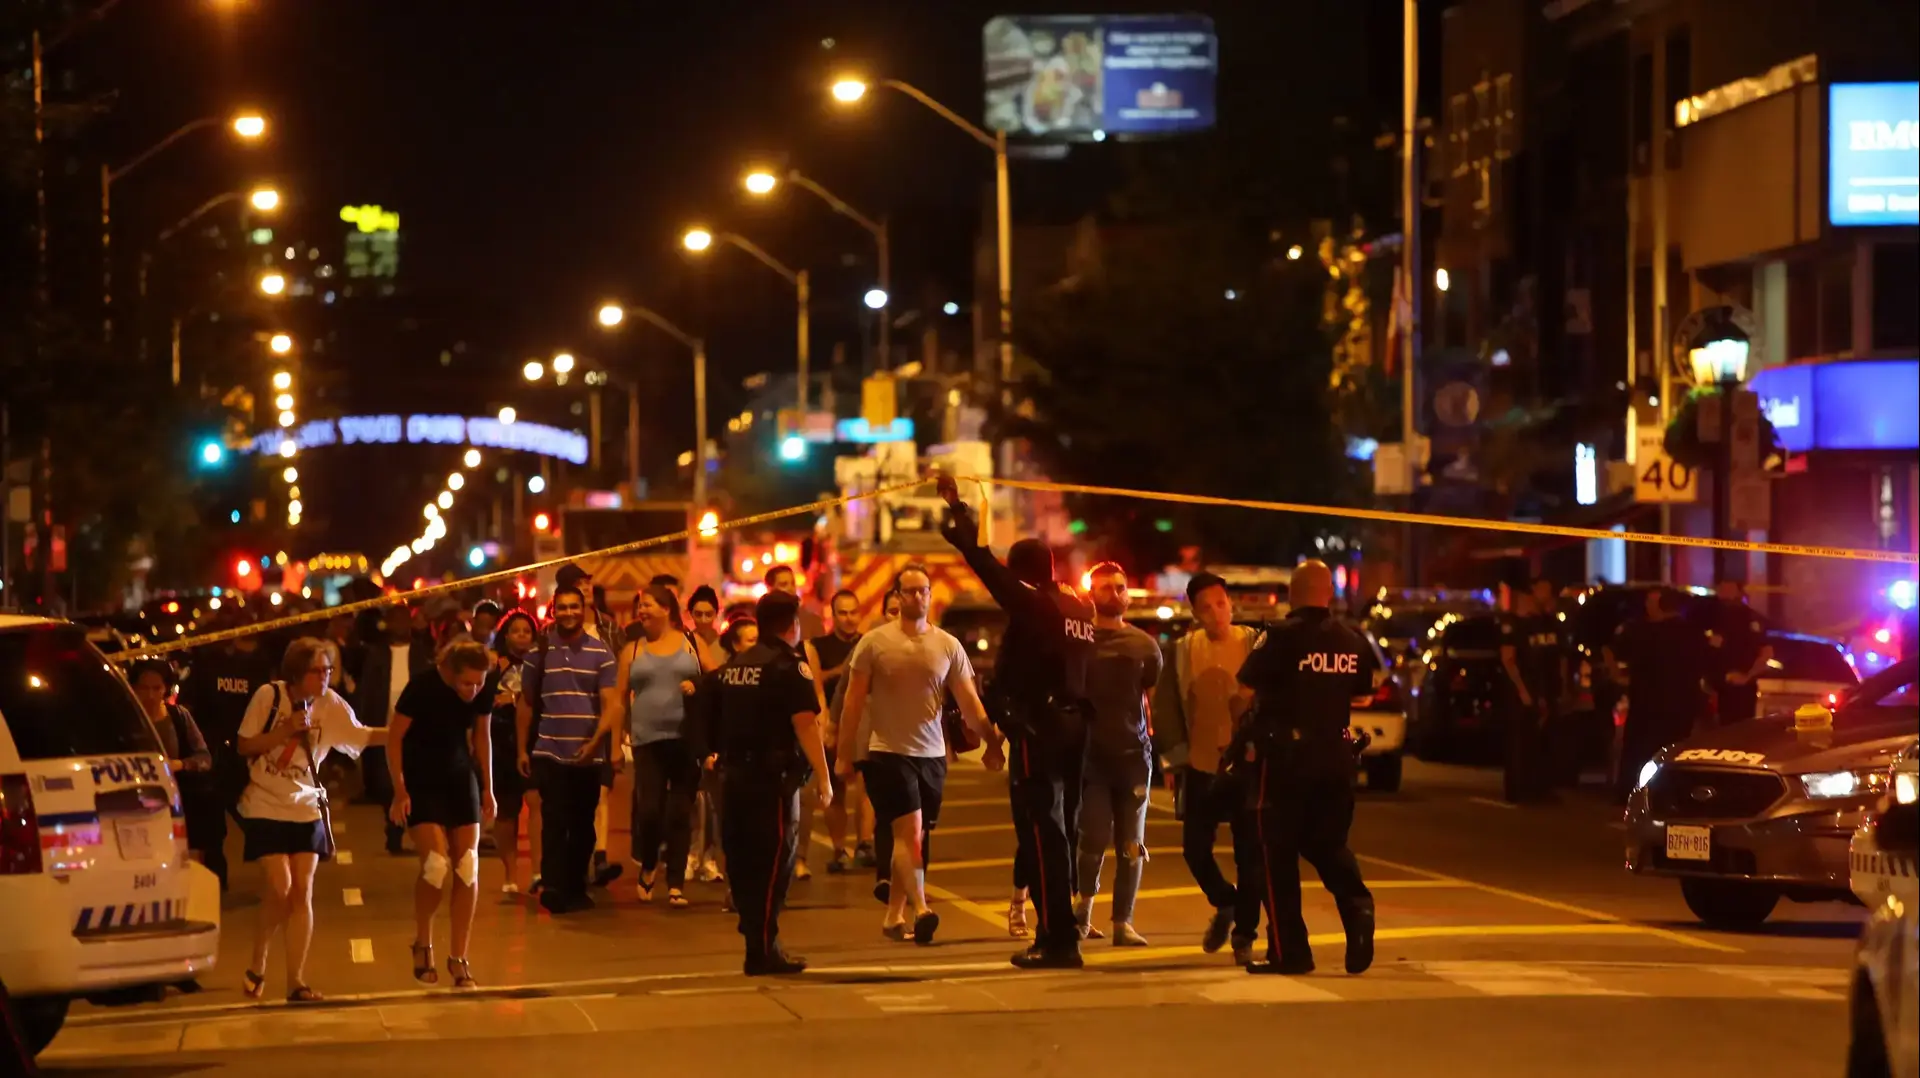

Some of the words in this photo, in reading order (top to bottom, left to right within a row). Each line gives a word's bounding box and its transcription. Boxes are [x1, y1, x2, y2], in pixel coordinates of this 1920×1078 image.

[1641, 459, 1690, 493] 40
[1065, 618, 1095, 644] POLICE
[1298, 653, 1358, 674] POLICE
[217, 677, 249, 694] POLICE
[722, 667, 762, 686] POLICE
[91, 756, 160, 786] POLICE
